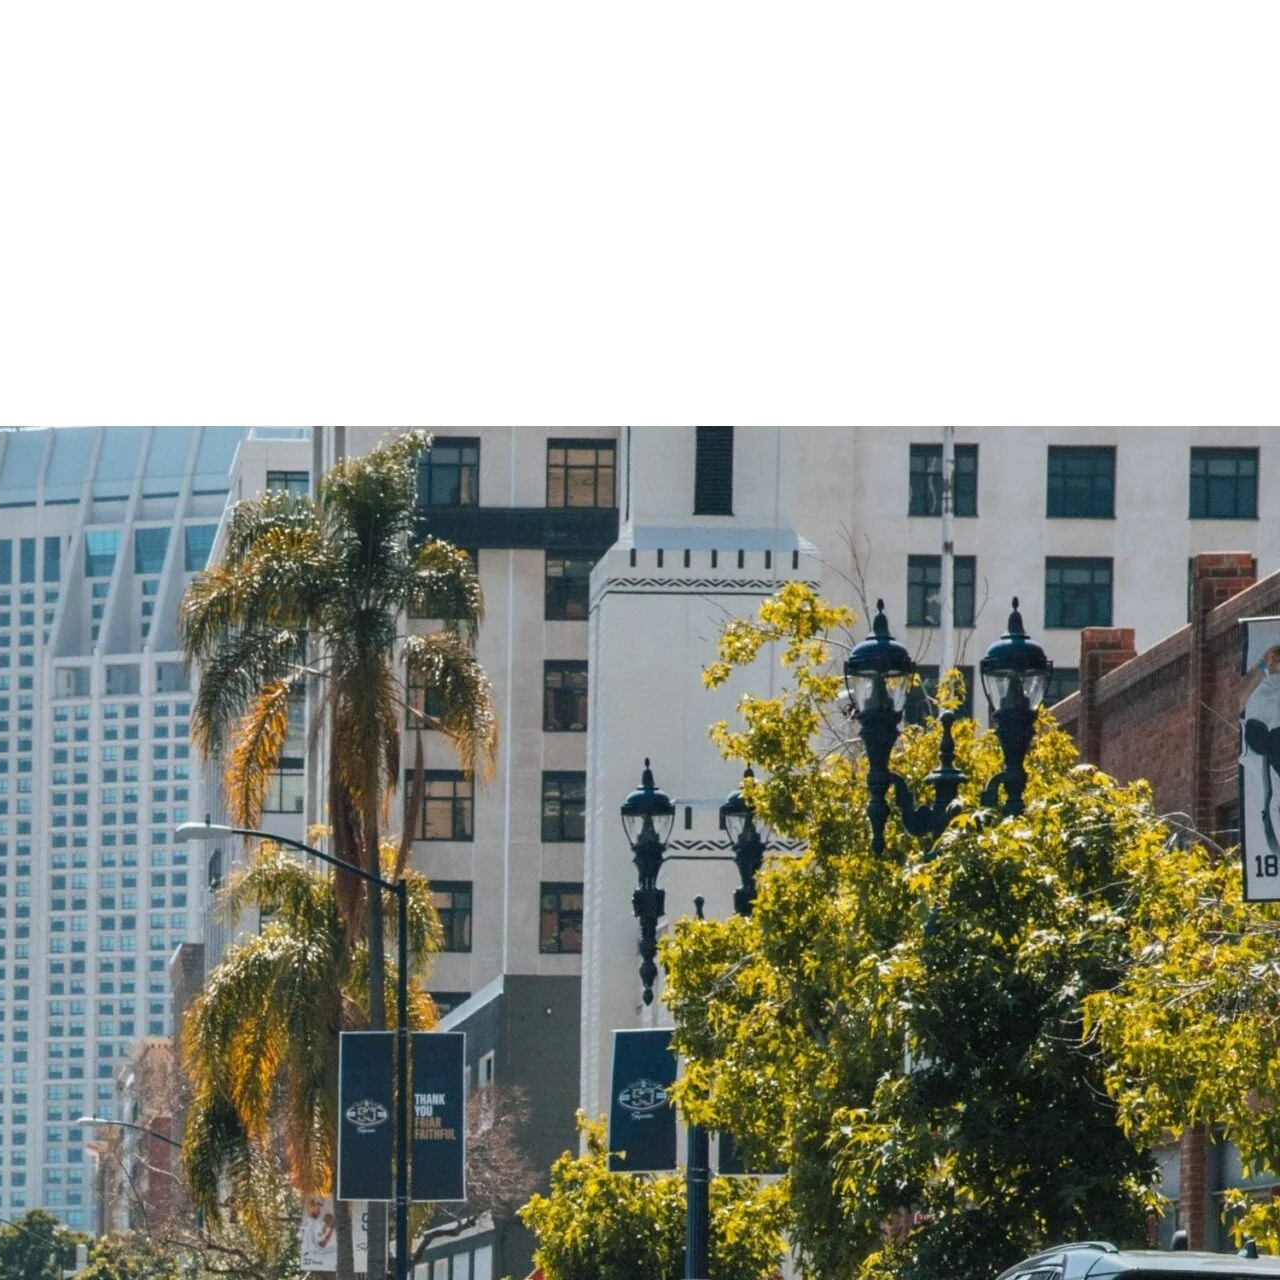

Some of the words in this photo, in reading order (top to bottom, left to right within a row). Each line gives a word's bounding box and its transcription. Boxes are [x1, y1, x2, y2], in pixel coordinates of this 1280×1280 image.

[1255, 855, 1278, 878] 18
[414, 1093, 445, 1105] THANK
[414, 1105, 433, 1117] YOU
[414, 1117, 441, 1128] FRIAR
[414, 1128, 456, 1140] FAITHFUL
